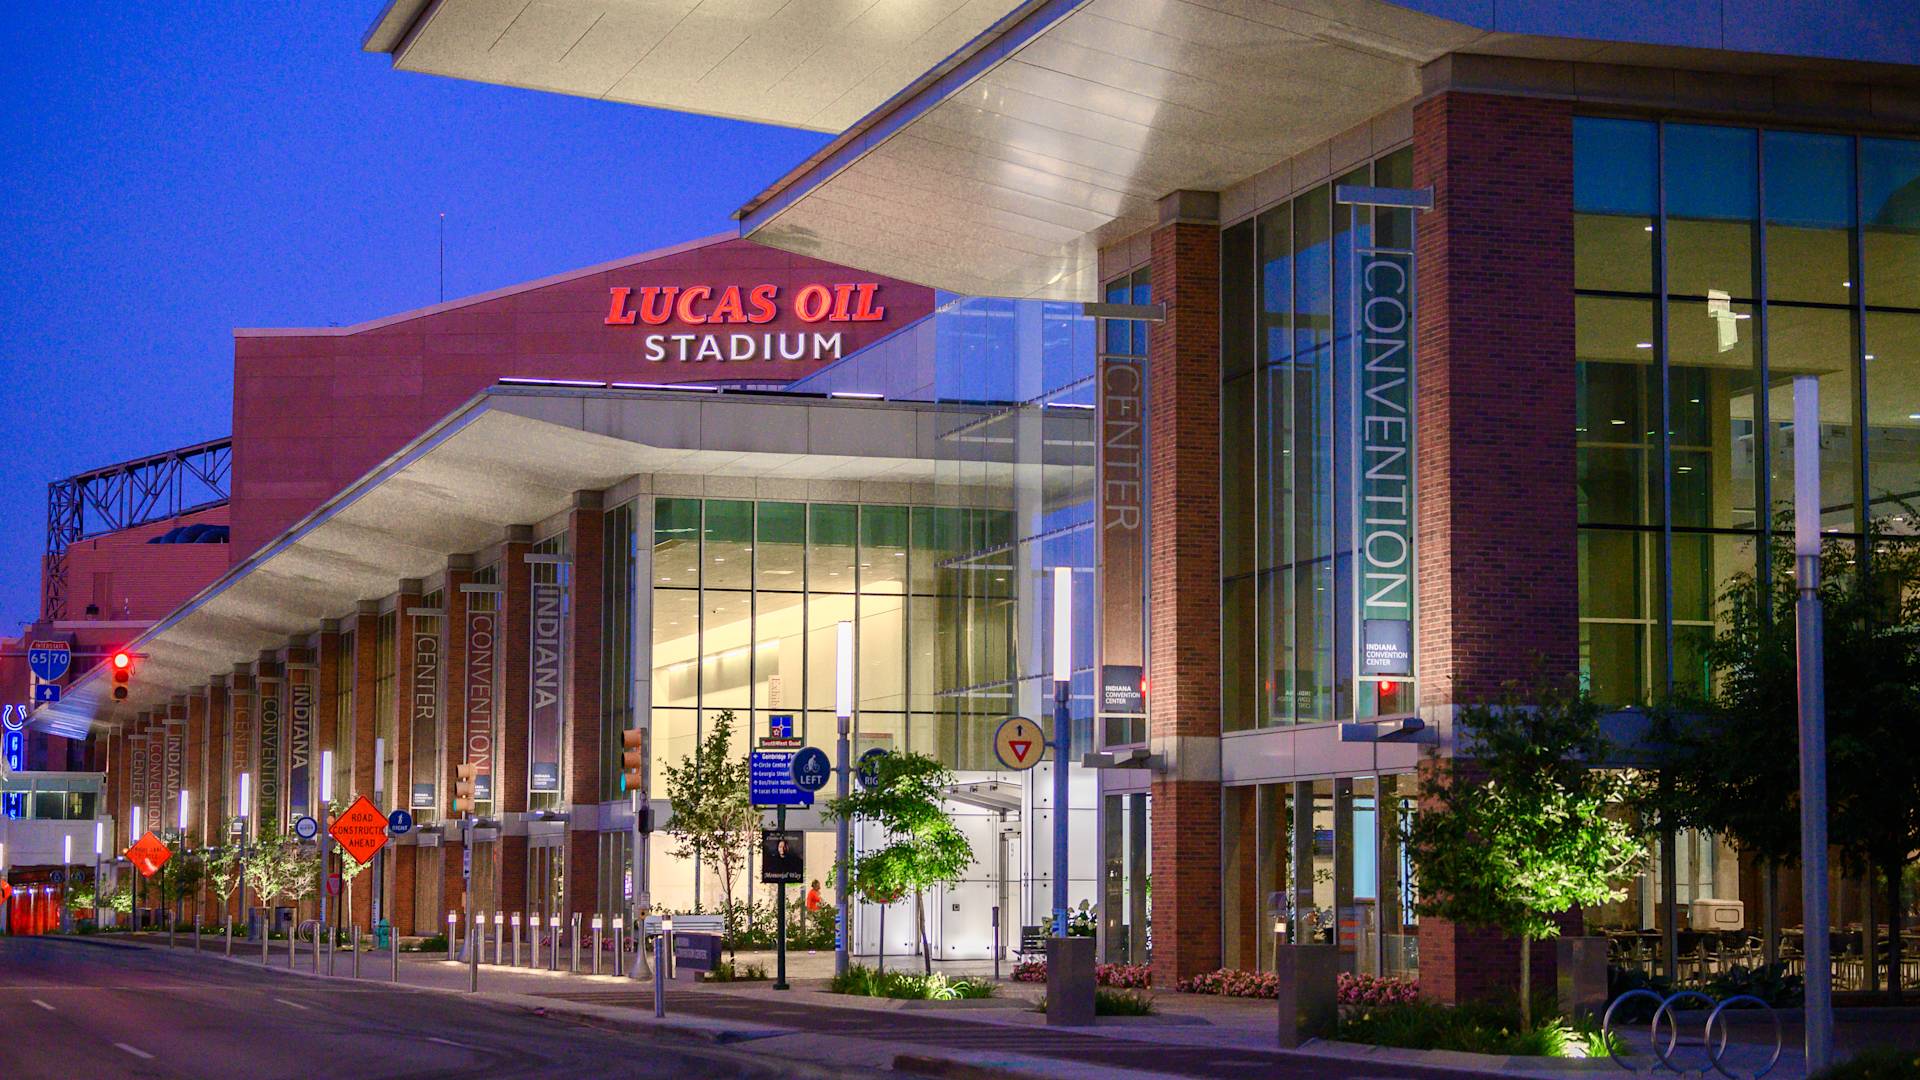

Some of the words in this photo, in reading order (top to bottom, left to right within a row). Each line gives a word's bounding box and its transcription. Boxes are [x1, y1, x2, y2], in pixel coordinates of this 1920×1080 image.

[604, 284, 779, 324] LUCAS
[794, 283, 885, 323] OIL
[645, 333, 842, 362] STADIUM
[1104, 364, 1141, 531] CENTER
[1364, 260, 1408, 609] CONVENTION
[31, 653, 47, 664] 65
[52, 653, 68, 665] 70
[535, 587, 559, 709] INDIANA
[1366, 651, 1408, 659] CONVENTION
[415, 637, 437, 719] CENTER
[469, 615, 493, 775] CONVENTION
[1105, 691, 1141, 699] CONVENTION
[234, 711, 249, 769] CENTER
[292, 685, 310, 769] INDIANA
[132, 751, 145, 799] CENTER
[167, 737, 181, 799] INDIANA
[261, 699, 277, 808] CONVENTION
[149, 745, 162, 828] CONVENTION
[800, 775, 823, 785] LEFT
[864, 776, 878, 785] RIG
[333, 825, 384, 835] CONSTRUCTI
[352, 813, 373, 822] ROAD
[348, 839, 375, 848] AHEAD
